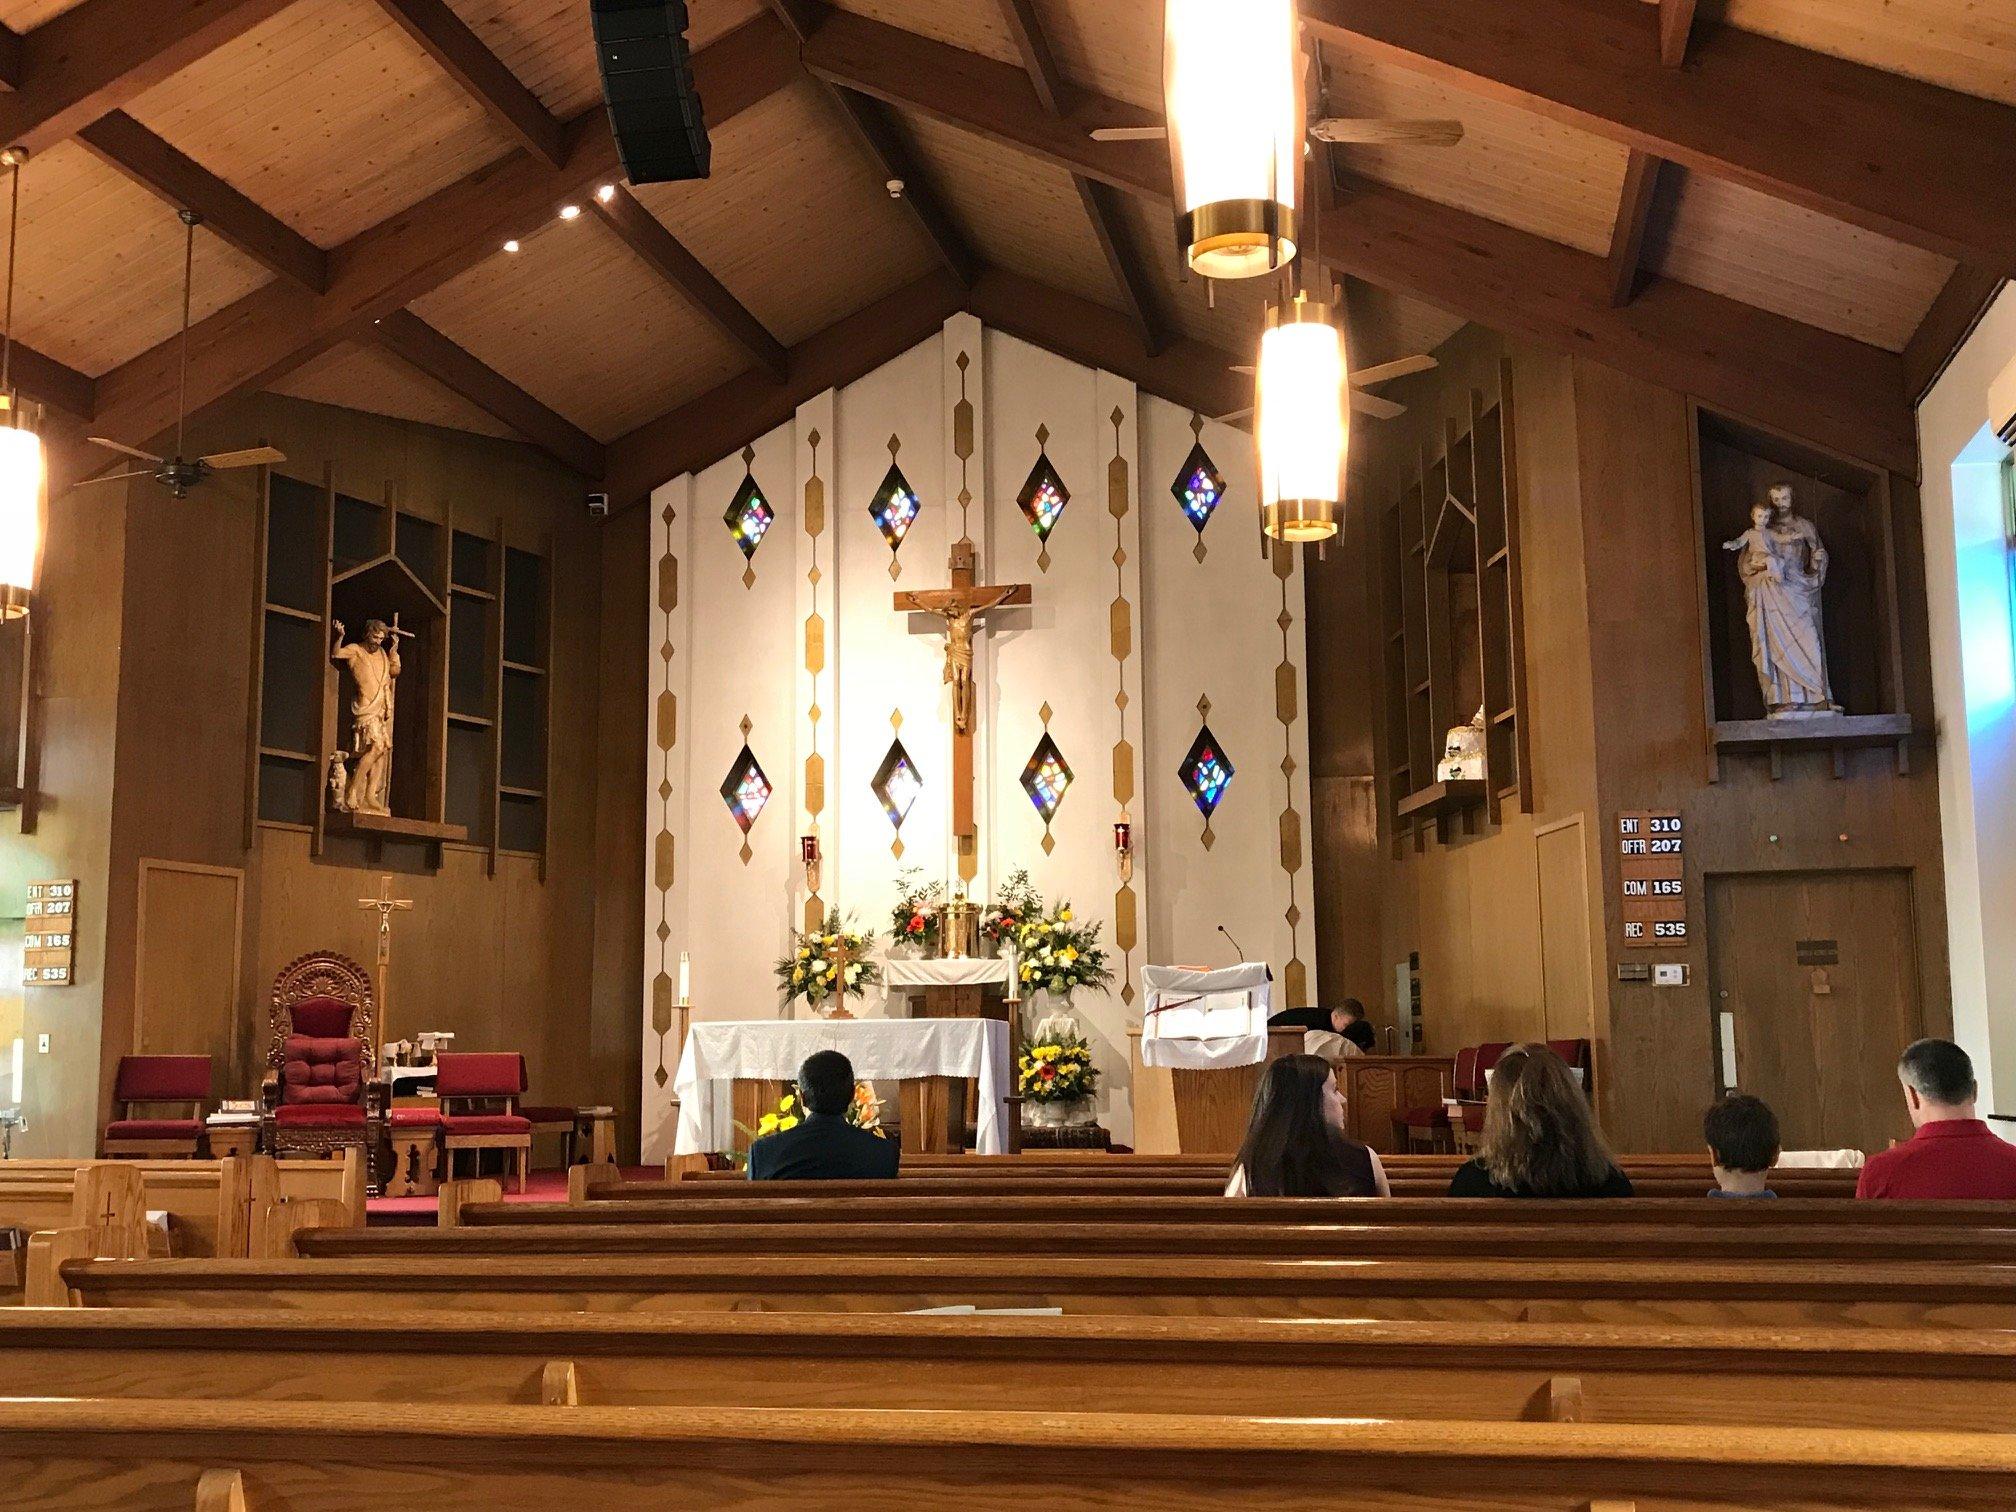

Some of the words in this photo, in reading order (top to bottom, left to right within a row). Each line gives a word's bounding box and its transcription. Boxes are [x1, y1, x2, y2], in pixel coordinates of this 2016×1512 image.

[1620, 818, 1639, 833] ENT
[1650, 818, 1681, 832] 310
[1621, 839, 1647, 854] OFFR
[1651, 839, 1682, 852] 207
[27, 885, 43, 898] ENT
[49, 885, 72, 897] 310
[1624, 880, 1647, 896] COM
[1653, 881, 1682, 894] 165
[46, 901, 71, 914] 207
[1625, 922, 1643, 938] REC
[1655, 922, 1686, 936] 535
[42, 967, 67, 980] 535
